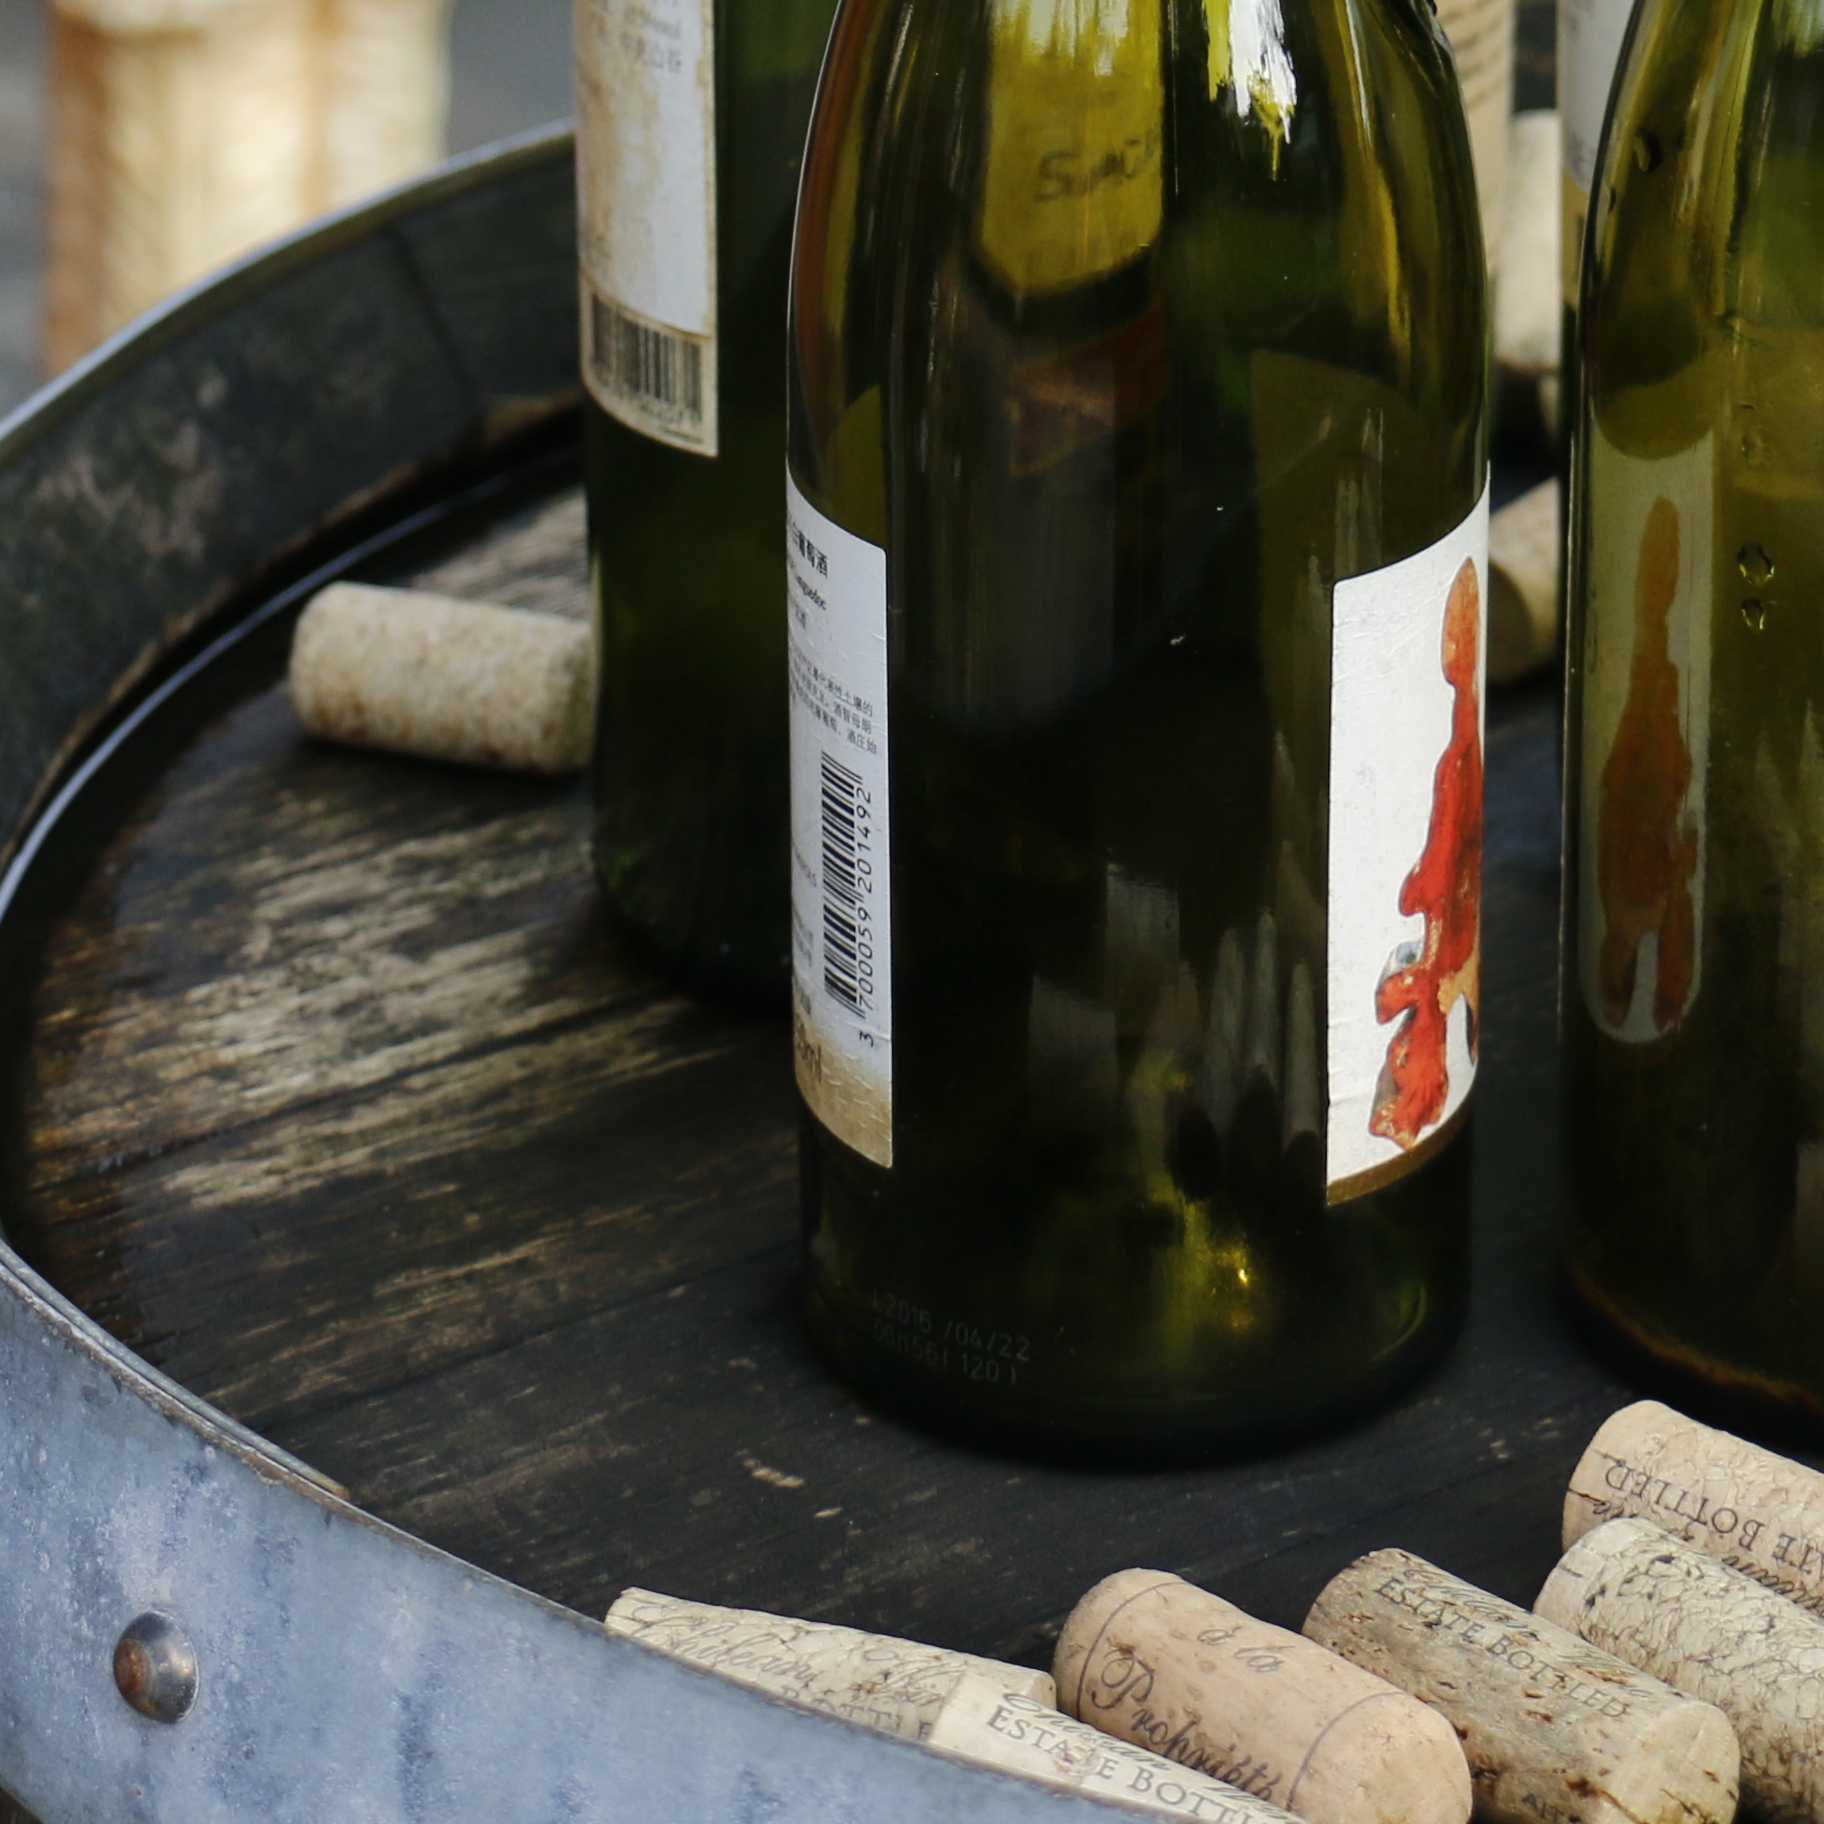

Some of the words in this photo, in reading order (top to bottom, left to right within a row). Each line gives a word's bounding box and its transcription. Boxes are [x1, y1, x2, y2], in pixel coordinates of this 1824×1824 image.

[856, 786, 873, 874] 201492
[857, 907, 874, 1012] 700059
[858, 1030, 874, 1047] 3
[1605, 1464, 1766, 1552] BOTTLED
[1377, 1578, 1489, 1644] ESTATE
[1485, 1632, 1631, 1719] BOTTLED
